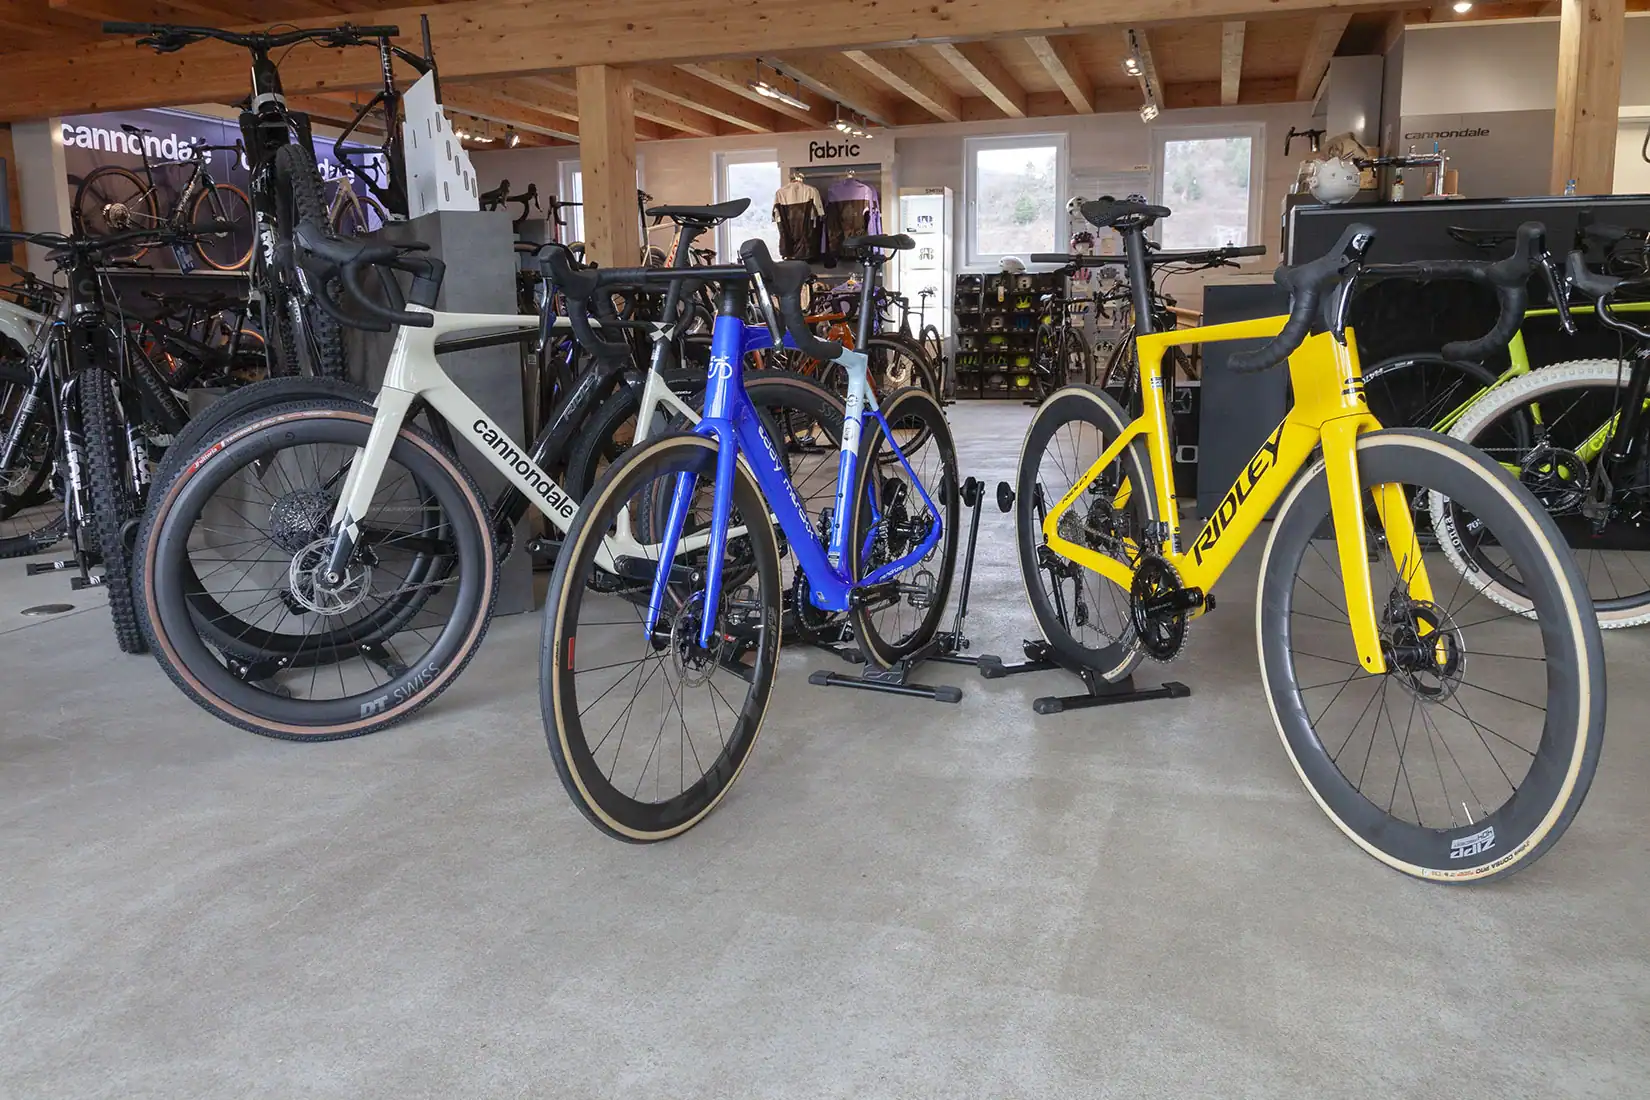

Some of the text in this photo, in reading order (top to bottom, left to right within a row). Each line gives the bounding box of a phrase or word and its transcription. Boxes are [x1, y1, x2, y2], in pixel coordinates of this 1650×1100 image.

[809, 139, 860, 162] fabric
[1404, 127, 1490, 140] cannondale
[473, 419, 574, 518] cannondale
[758, 425, 815, 539] eddy merckx
[1193, 416, 1288, 567] RIDLEY
[360, 662, 441, 719] DT SWISS
[1450, 838, 1496, 859] ZIPP
